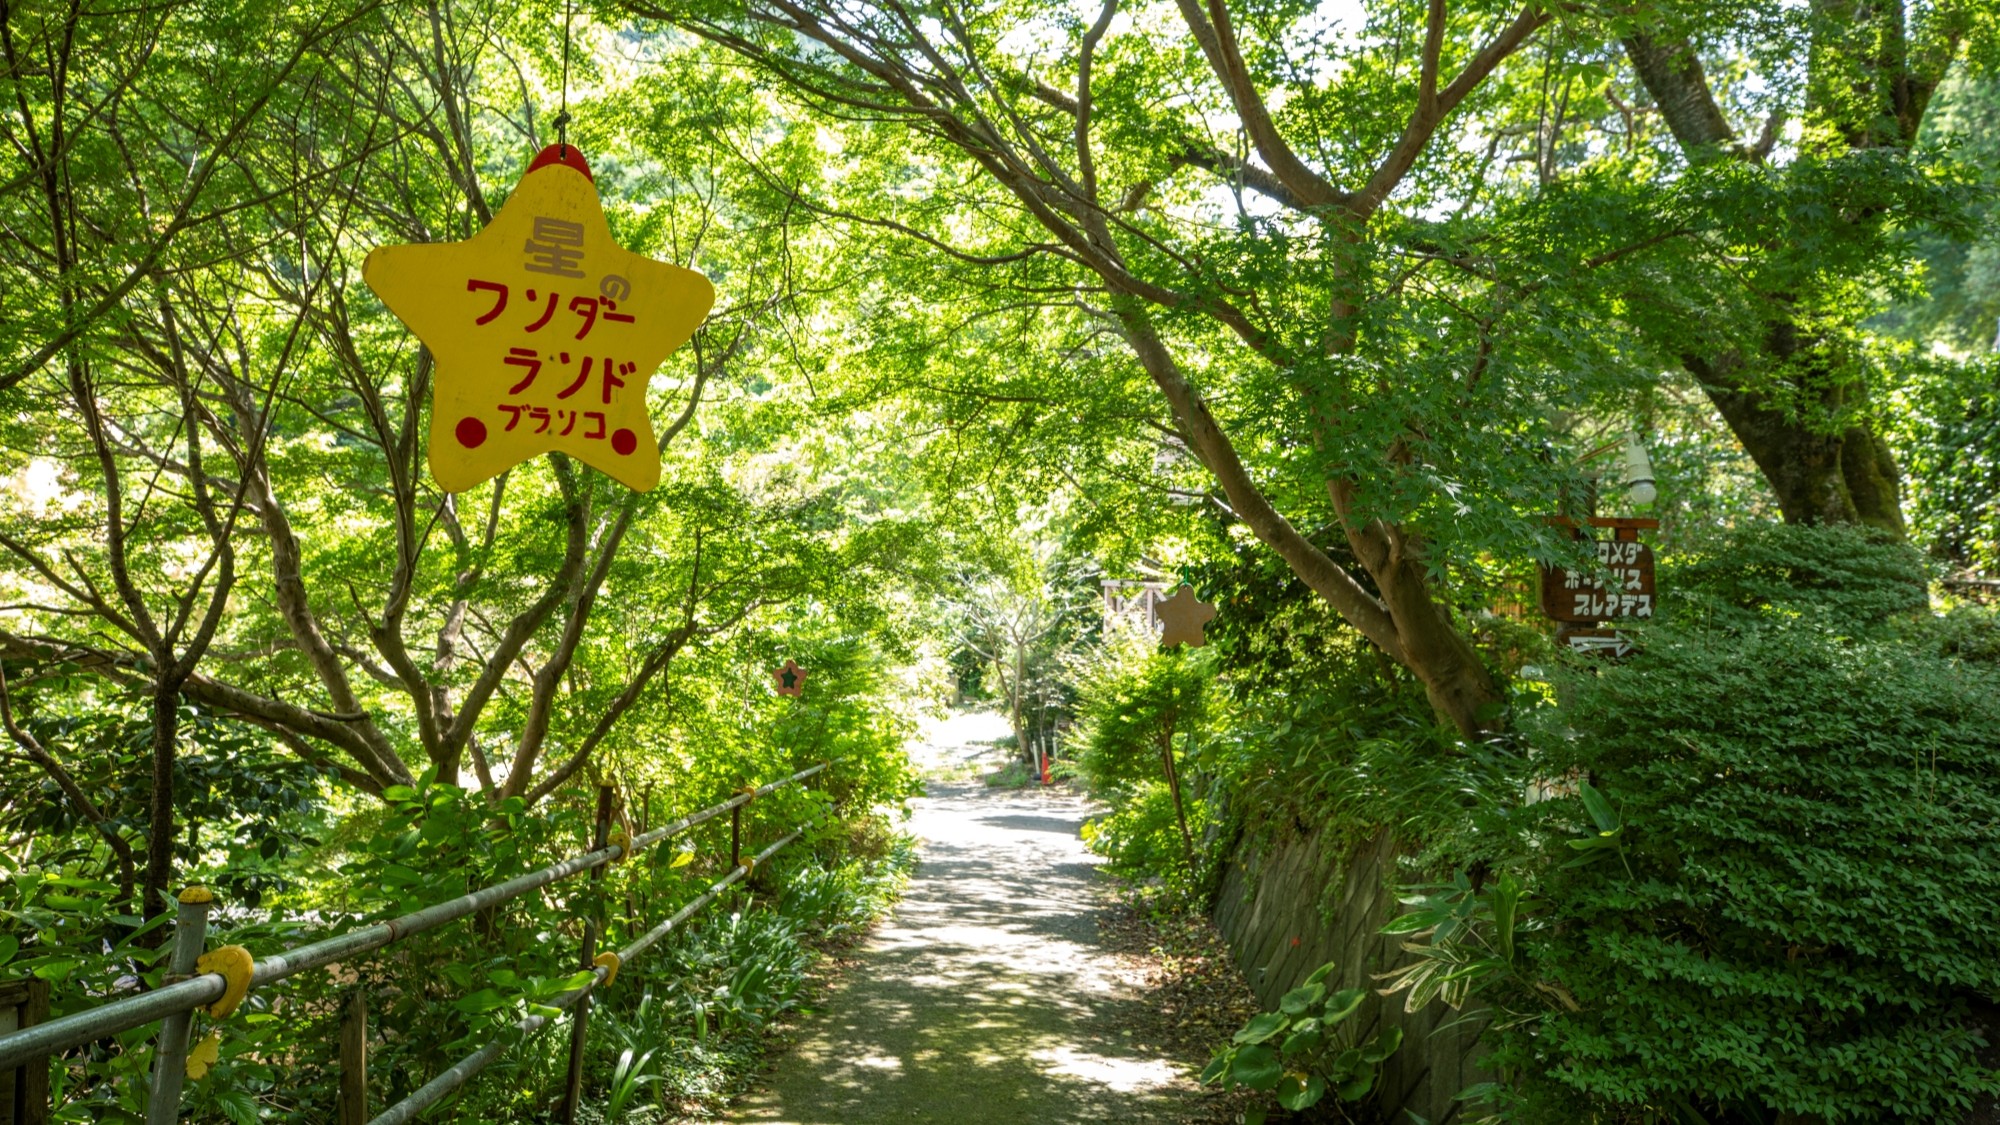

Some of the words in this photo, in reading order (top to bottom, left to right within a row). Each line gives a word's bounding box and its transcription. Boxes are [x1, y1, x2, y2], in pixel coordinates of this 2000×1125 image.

[524, 216, 631, 302] 星の
[1573, 594, 1652, 617] プレアデス
